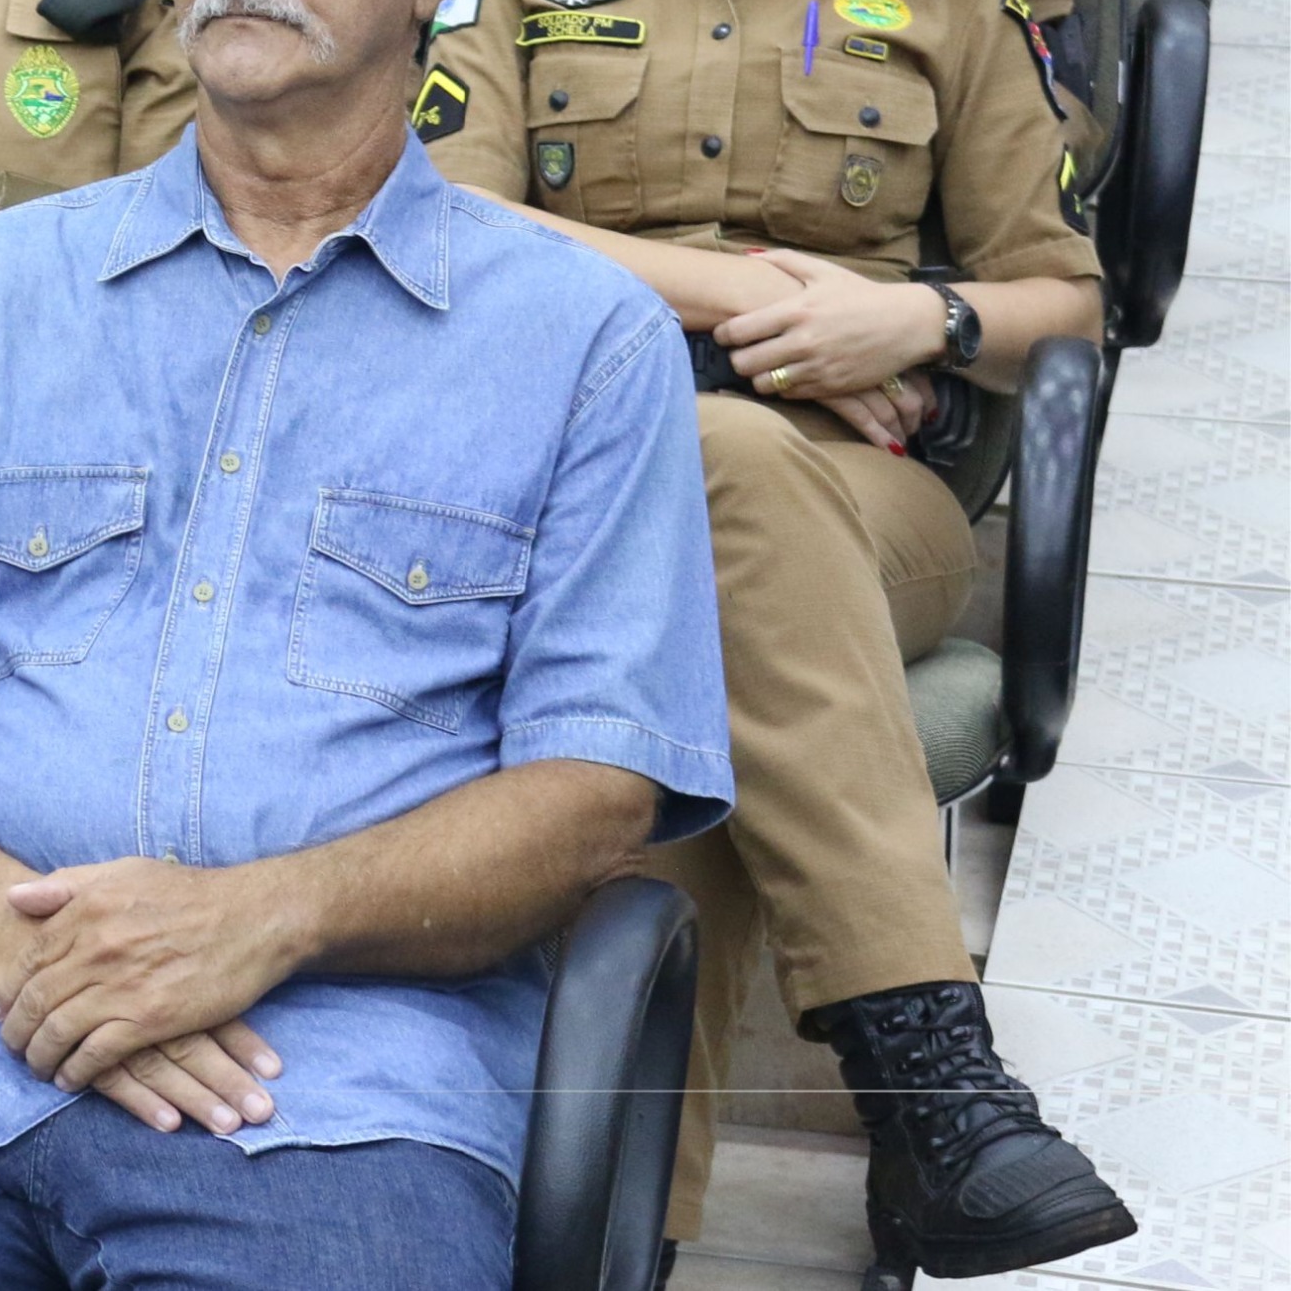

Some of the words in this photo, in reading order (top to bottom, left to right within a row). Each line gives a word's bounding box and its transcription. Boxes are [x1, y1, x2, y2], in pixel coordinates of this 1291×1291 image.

[537, 14, 591, 29] SOLDADO
[593, 17, 614, 28] PM
[547, 25, 597, 38] SCHEILA
